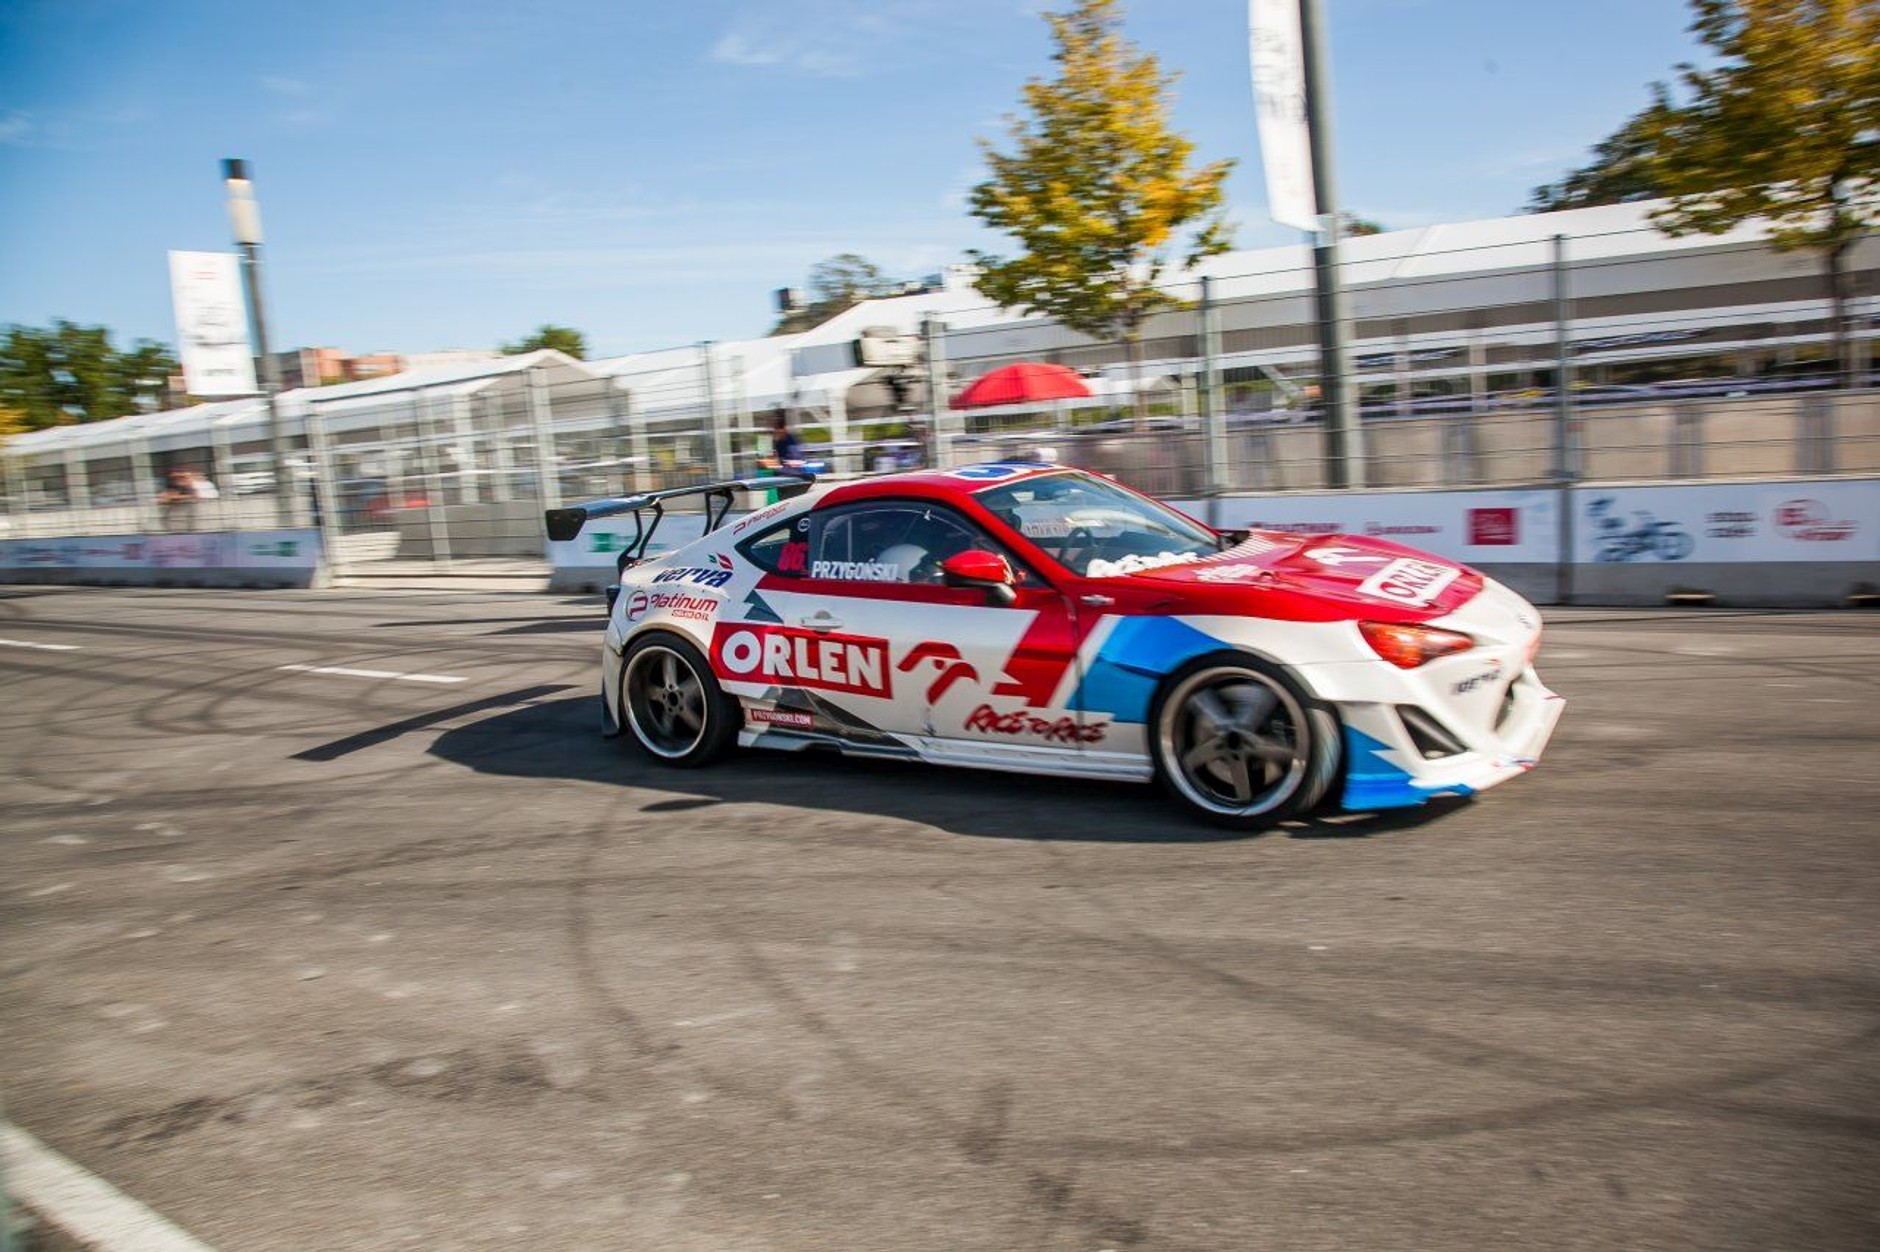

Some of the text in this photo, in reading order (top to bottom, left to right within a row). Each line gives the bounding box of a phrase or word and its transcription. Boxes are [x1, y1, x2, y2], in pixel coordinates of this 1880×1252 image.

[651, 568, 733, 588] verva
[811, 558, 899, 580] PRZYGOŃSKI
[651, 593, 718, 612] Platinum
[722, 630, 883, 690] ORLEN
